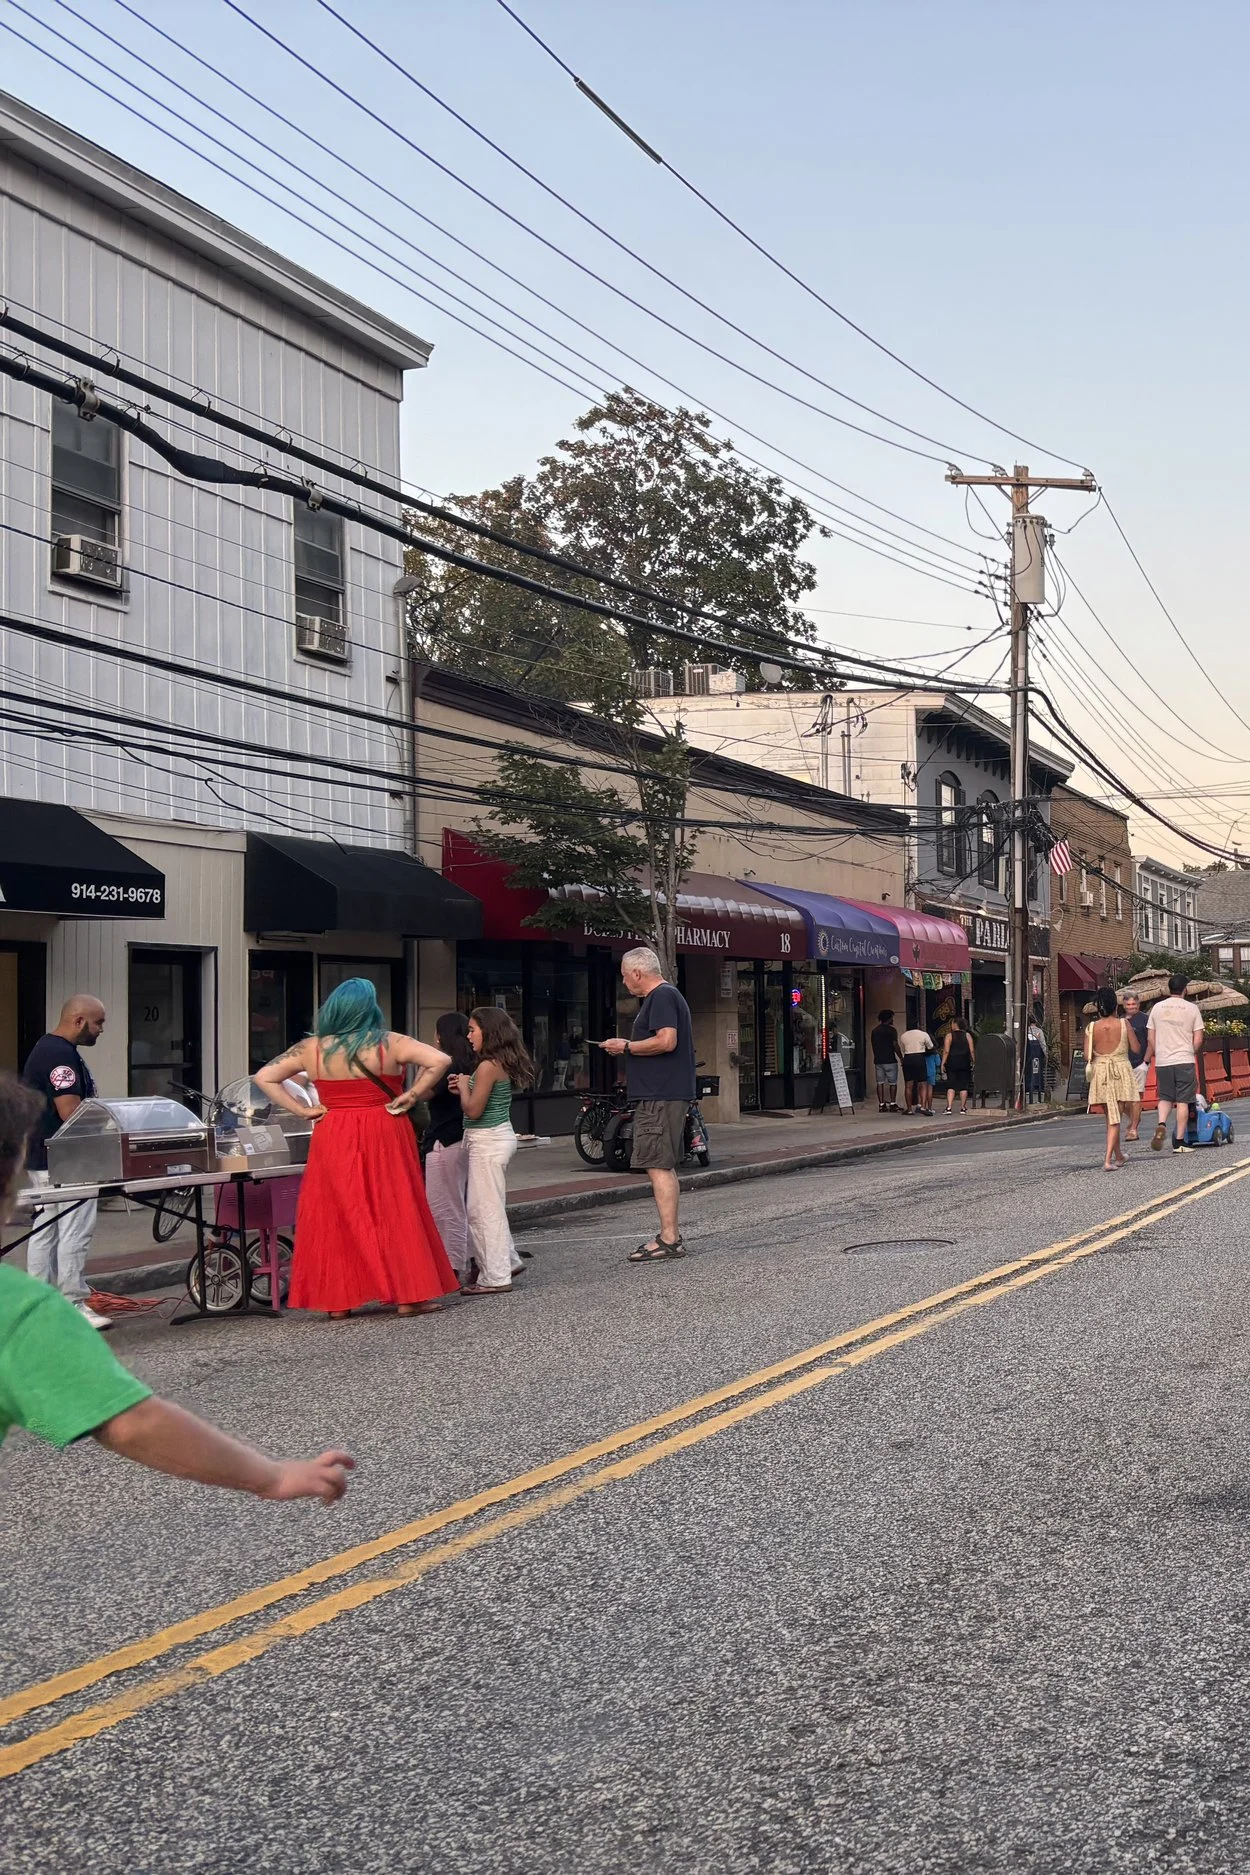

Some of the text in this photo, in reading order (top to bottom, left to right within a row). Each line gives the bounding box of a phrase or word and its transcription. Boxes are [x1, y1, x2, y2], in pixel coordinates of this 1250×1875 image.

[71, 882, 161, 904] 914-231-9678
[674, 926, 731, 949] HARMACY
[780, 933, 791, 953] 18
[976, 917, 1010, 949] PARL
[144, 1006, 160, 1022] 20
